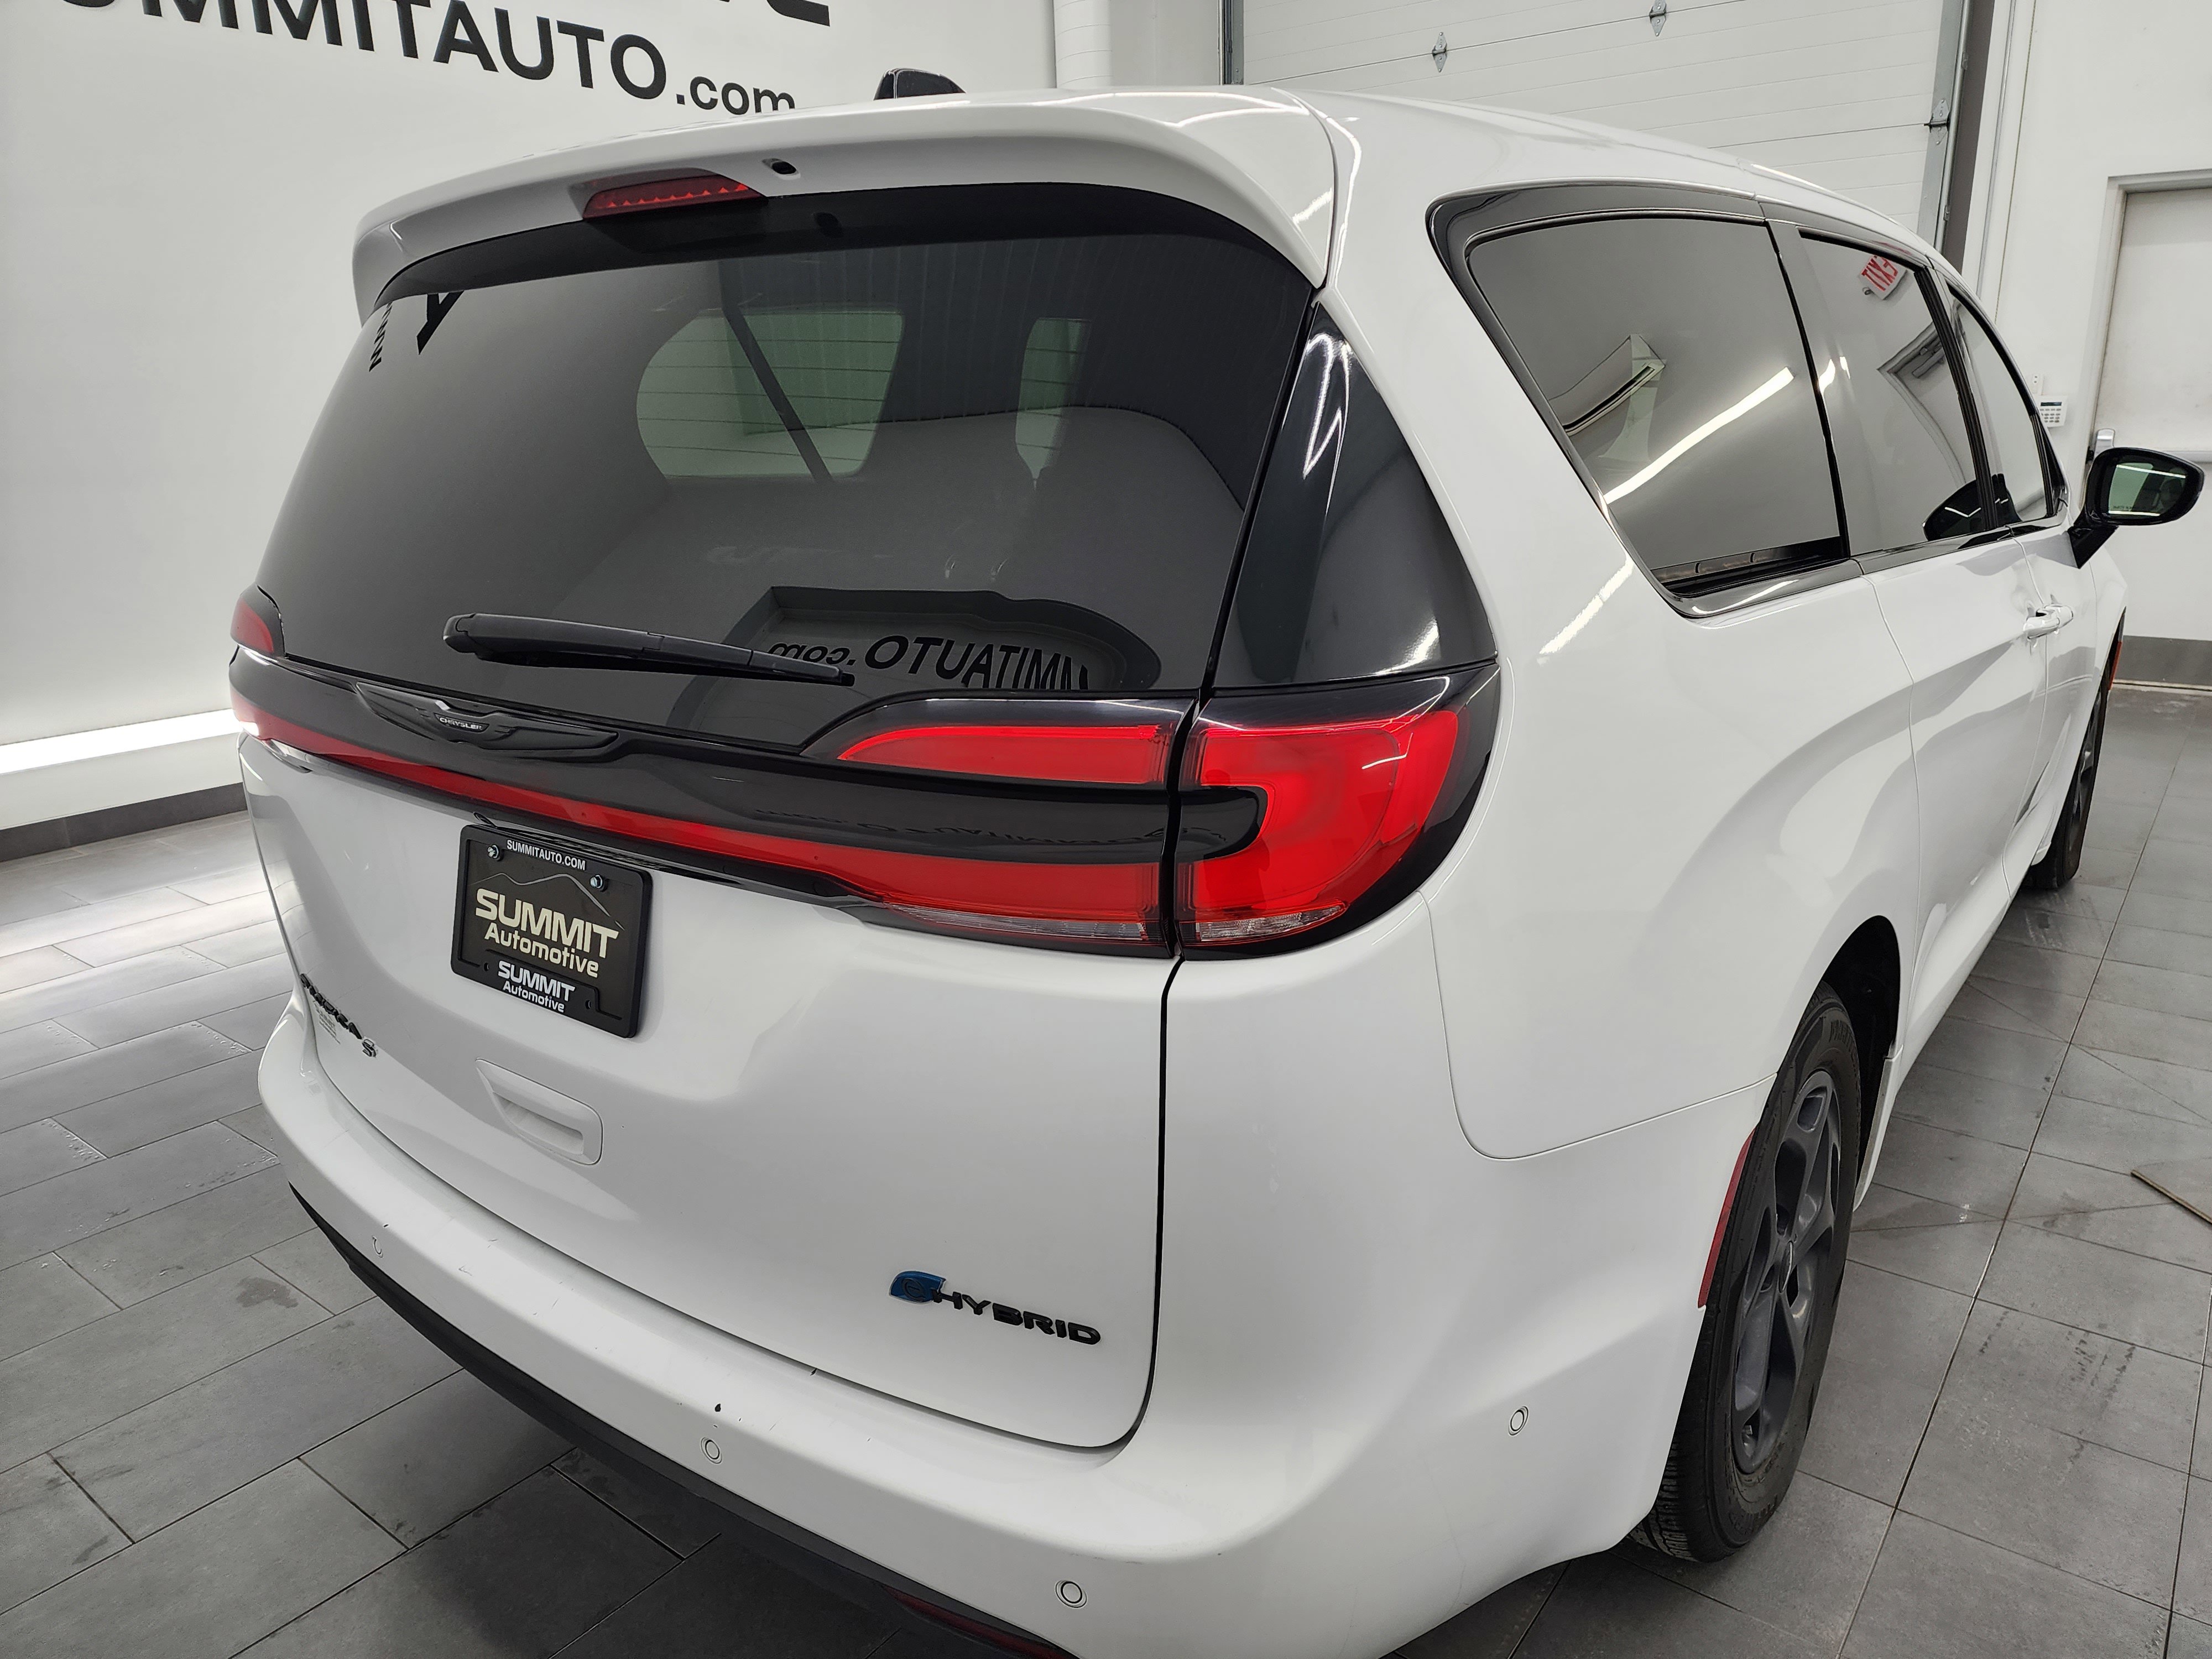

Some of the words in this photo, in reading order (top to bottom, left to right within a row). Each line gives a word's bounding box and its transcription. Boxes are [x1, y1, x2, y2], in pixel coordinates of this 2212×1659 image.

[440, 717, 483, 731] CHRYSLER
[507, 839, 586, 871] SUMMITAUTO.COM
[476, 888, 619, 959] SUMMIT
[484, 922, 599, 978] Automotive
[498, 960, 576, 1001] SUMMIT
[503, 980, 565, 1013] Automotive
